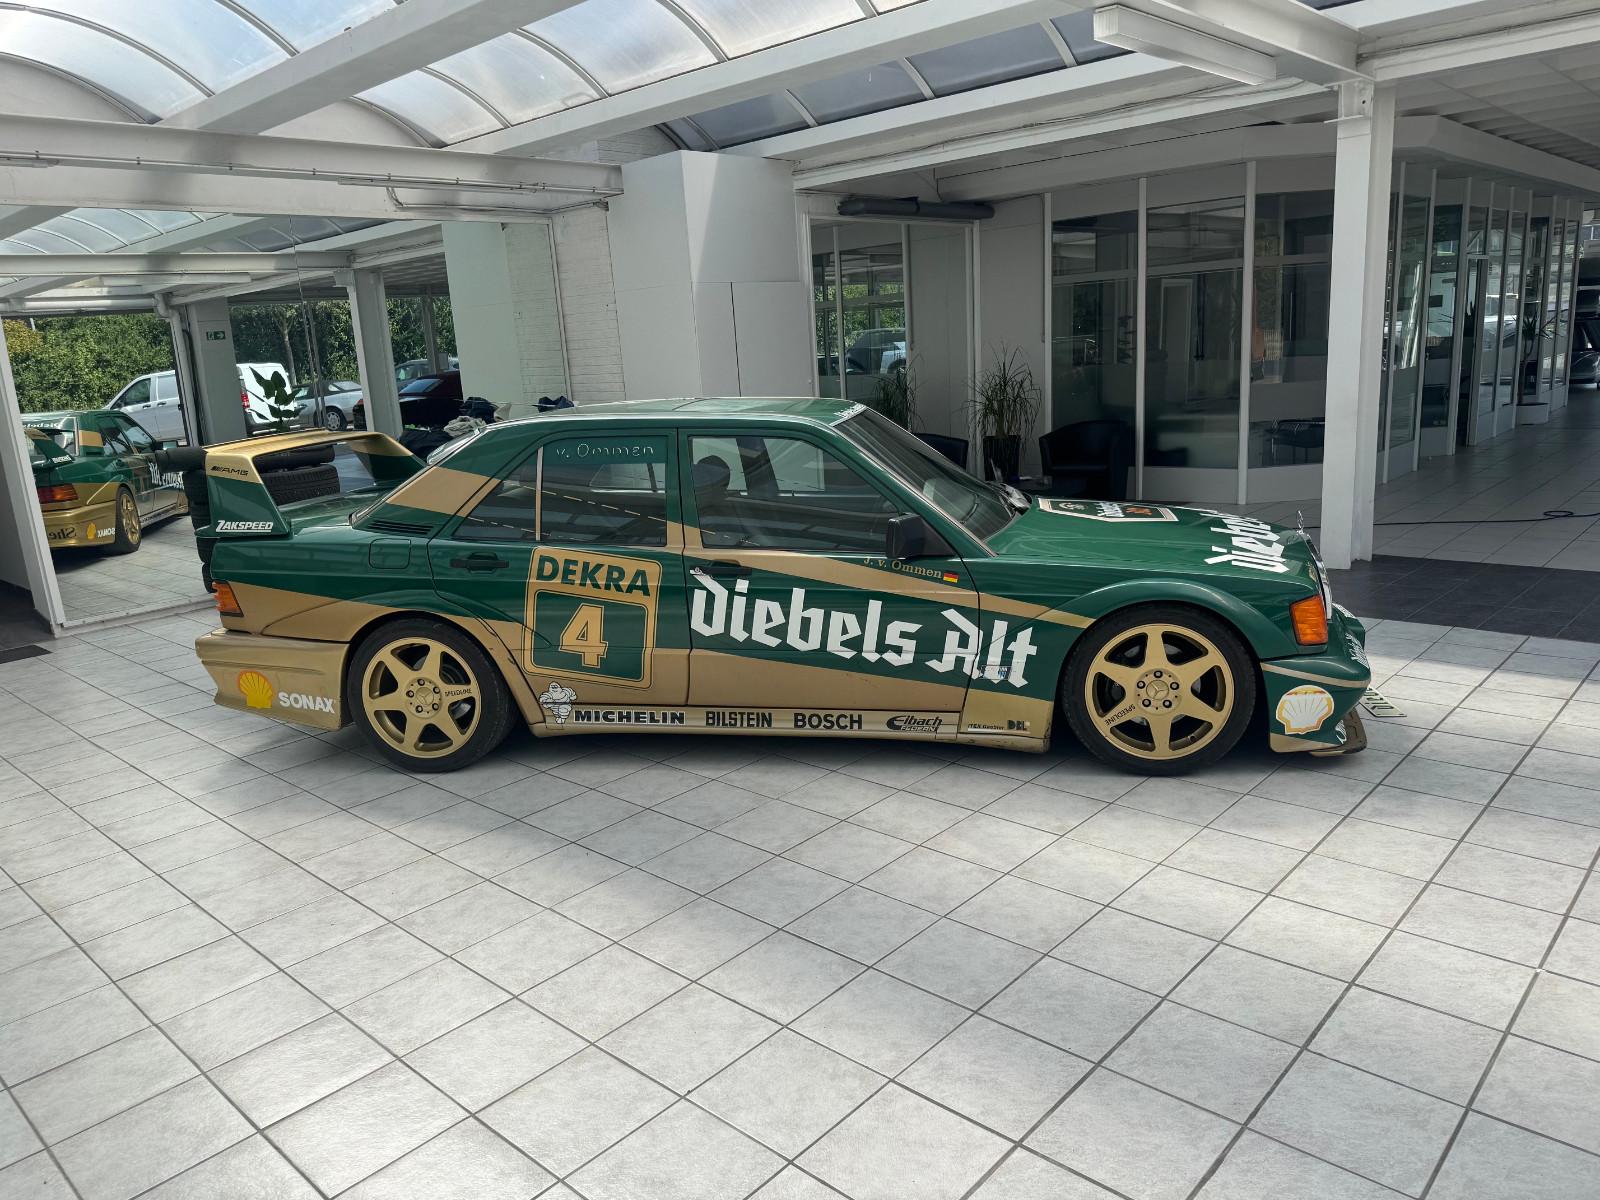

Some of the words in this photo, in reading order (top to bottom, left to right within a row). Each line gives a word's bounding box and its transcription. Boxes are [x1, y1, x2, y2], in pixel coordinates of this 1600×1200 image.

[577, 443, 654, 457] Ommen
[221, 466, 249, 476] AMG
[215, 520, 274, 533] ZAKSPEED
[536, 554, 651, 597] DEKRA
[891, 561, 942, 579] Ommen
[558, 602, 609, 669] 4
[689, 568, 923, 667] Diebels
[924, 608, 1038, 688] Alt
[277, 691, 335, 714] SONAX
[573, 710, 685, 725] MICHELIN
[705, 711, 773, 728] BILSTEIN
[793, 712, 863, 731] BOSCH
[886, 714, 943, 732] Eibach
[1104, 703, 1137, 726] SPEEDLINE
